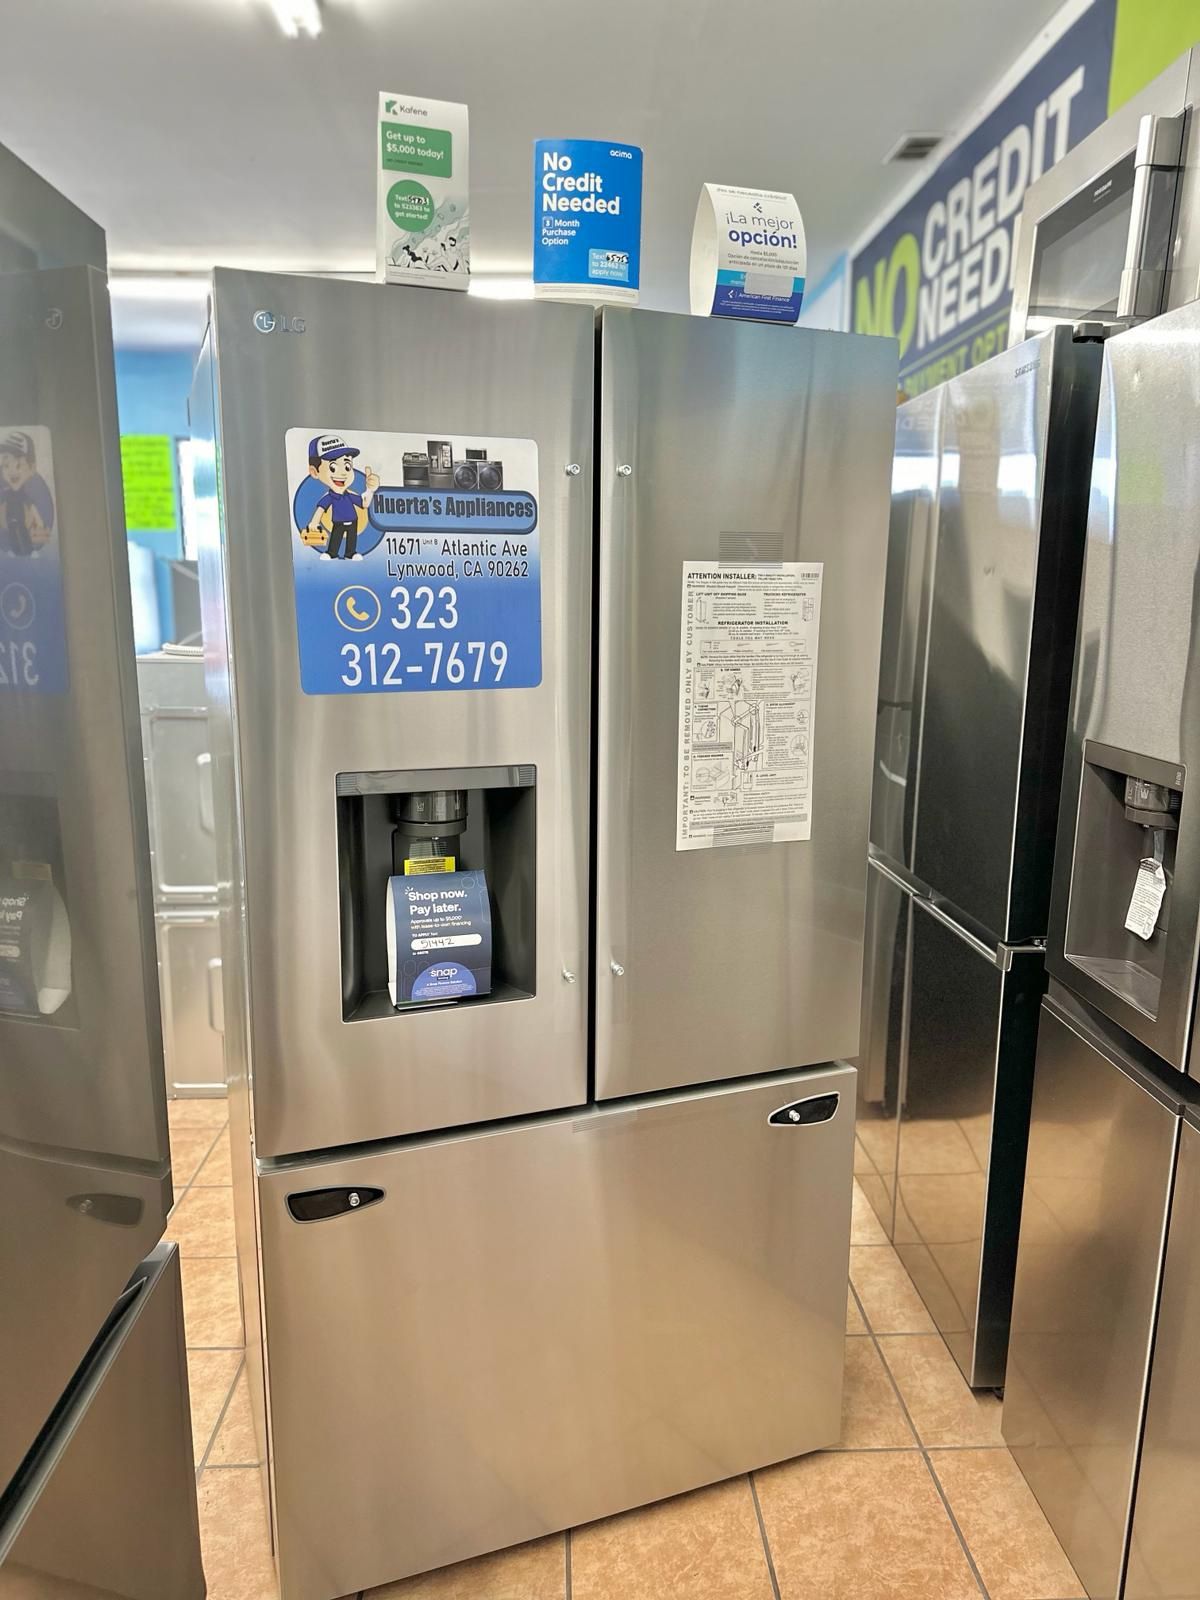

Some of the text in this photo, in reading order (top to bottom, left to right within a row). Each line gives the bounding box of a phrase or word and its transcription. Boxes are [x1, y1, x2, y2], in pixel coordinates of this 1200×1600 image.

[400, 105, 428, 117] Kafene
[386, 130, 426, 144] Get up to
[417, 148, 444, 160] today!
[543, 152, 572, 172] No
[610, 150, 632, 160] acima
[922, 65, 1085, 279] CREDIT
[542, 172, 603, 192] Credit
[542, 193, 620, 215] Needed
[554, 219, 580, 228] Month
[726, 211, 794, 231] ¡La mejor
[542, 228, 576, 236] Purchase
[728, 229, 797, 249] opción!
[542, 237, 569, 247] Option
[918, 225, 1015, 349] NEED
[856, 233, 920, 361] NO
[373, 494, 534, 518] Huerta's Appliances
[386, 538, 421, 556] 11671
[441, 539, 497, 556] Atlantic
[502, 539, 528, 556] Ave
[387, 560, 529, 580] Lynwood, CA 90262
[390, 586, 458, 630] 323
[340, 640, 508, 687] 312-7679
[686, 650, 692, 663] BY
[684, 748, 690, 760] BE
[684, 765, 690, 776] TO
[408, 890, 468, 902] Shop now.
[410, 903, 462, 916] Pay later.
[430, 968, 458, 978] snap
